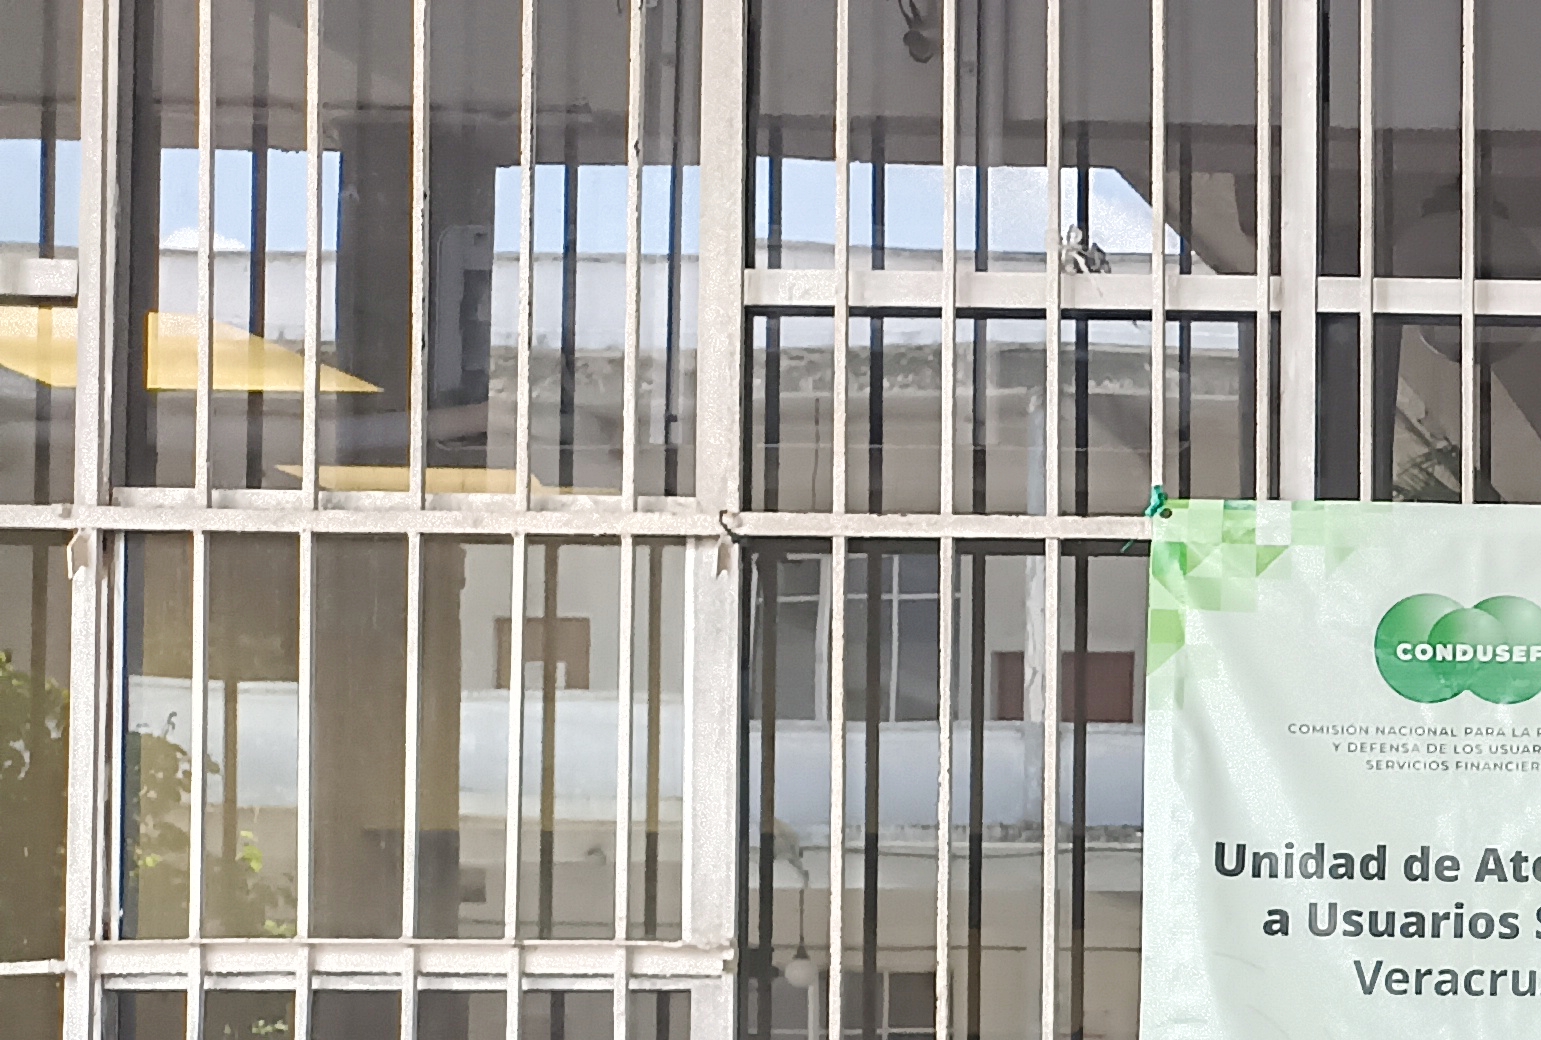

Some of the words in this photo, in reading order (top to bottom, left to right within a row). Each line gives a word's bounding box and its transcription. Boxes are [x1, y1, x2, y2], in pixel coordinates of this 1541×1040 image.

[1288, 722, 1369, 735] COMISIÓN
[1376, 726, 1458, 737] NACIONAL
[1465, 727, 1505, 737] PARA
[1512, 727, 1530, 737] LA
[1333, 742, 1340, 752] Y
[1348, 742, 1420, 754] DEFENSA
[1427, 743, 1446, 754] DE
[1453, 744, 1483, 754] LOS
[1366, 760, 1449, 770] SERVICIOS
[1214, 841, 1387, 882] Unidad
[1402, 845, 1461, 882] de
[1263, 908, 1290, 937] a
[1308, 901, 1520, 938] Usuarios
